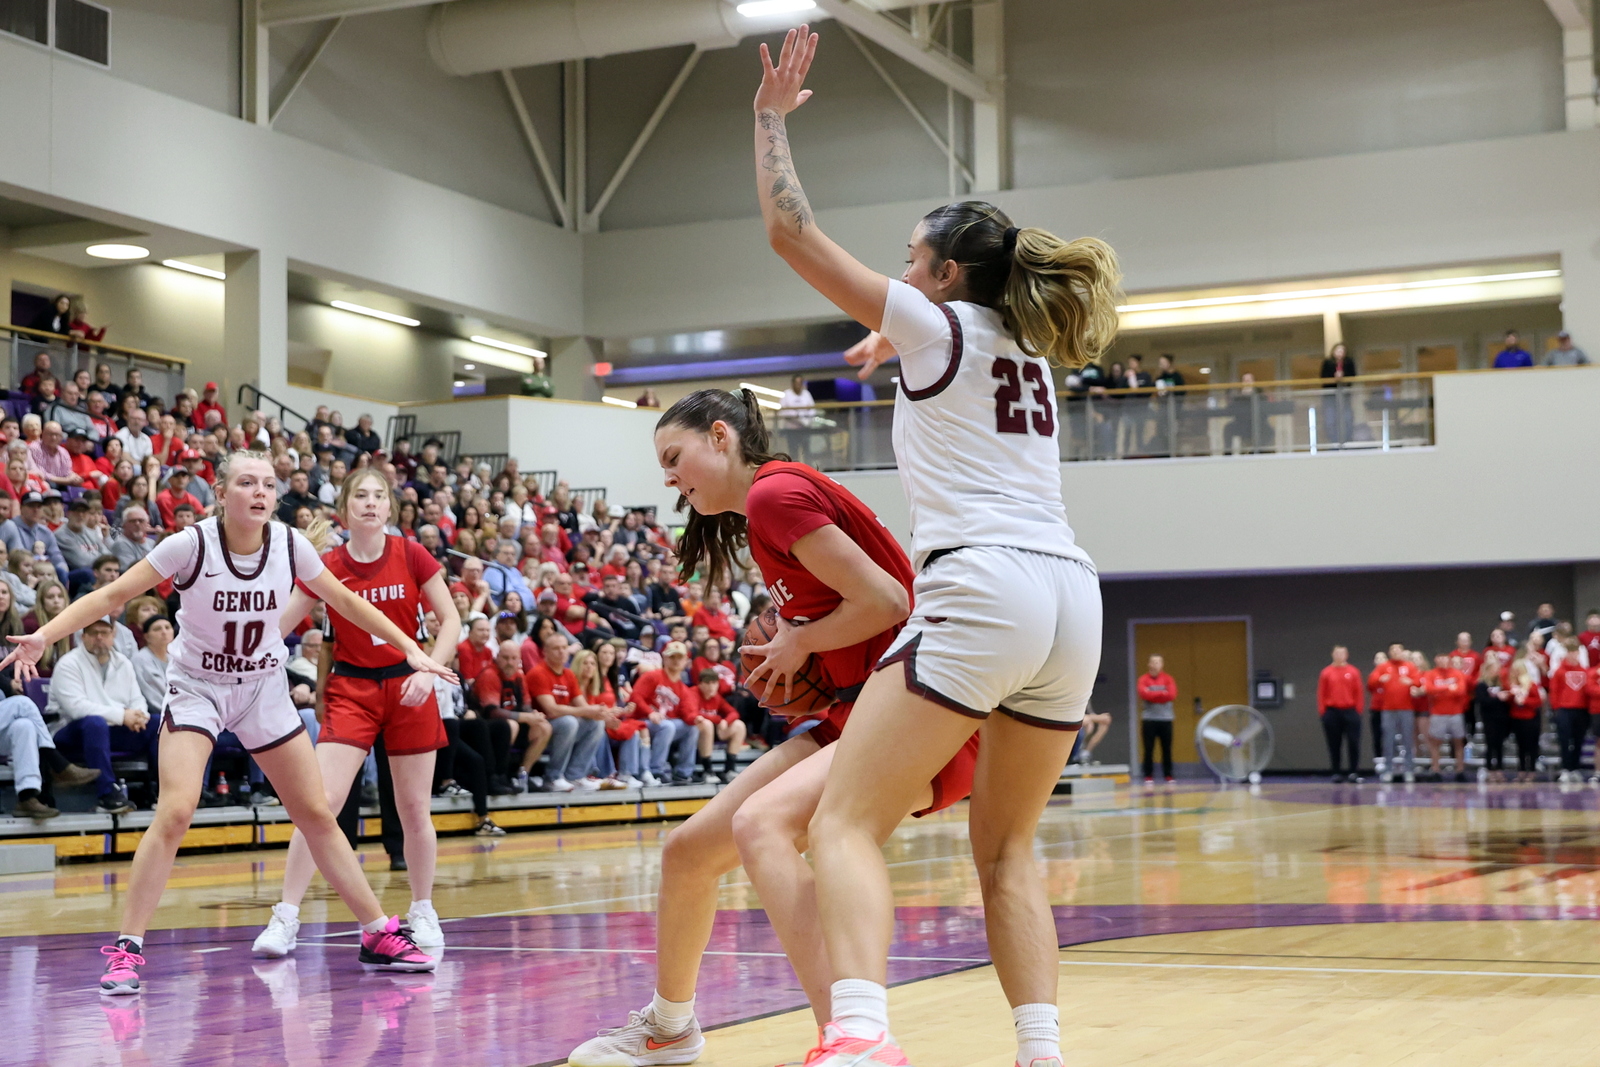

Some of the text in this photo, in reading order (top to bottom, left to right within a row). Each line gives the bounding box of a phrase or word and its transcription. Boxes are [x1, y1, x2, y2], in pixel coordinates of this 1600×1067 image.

[992, 357, 1055, 438] 23
[213, 590, 278, 613] GENOA
[222, 620, 265, 657] 10
